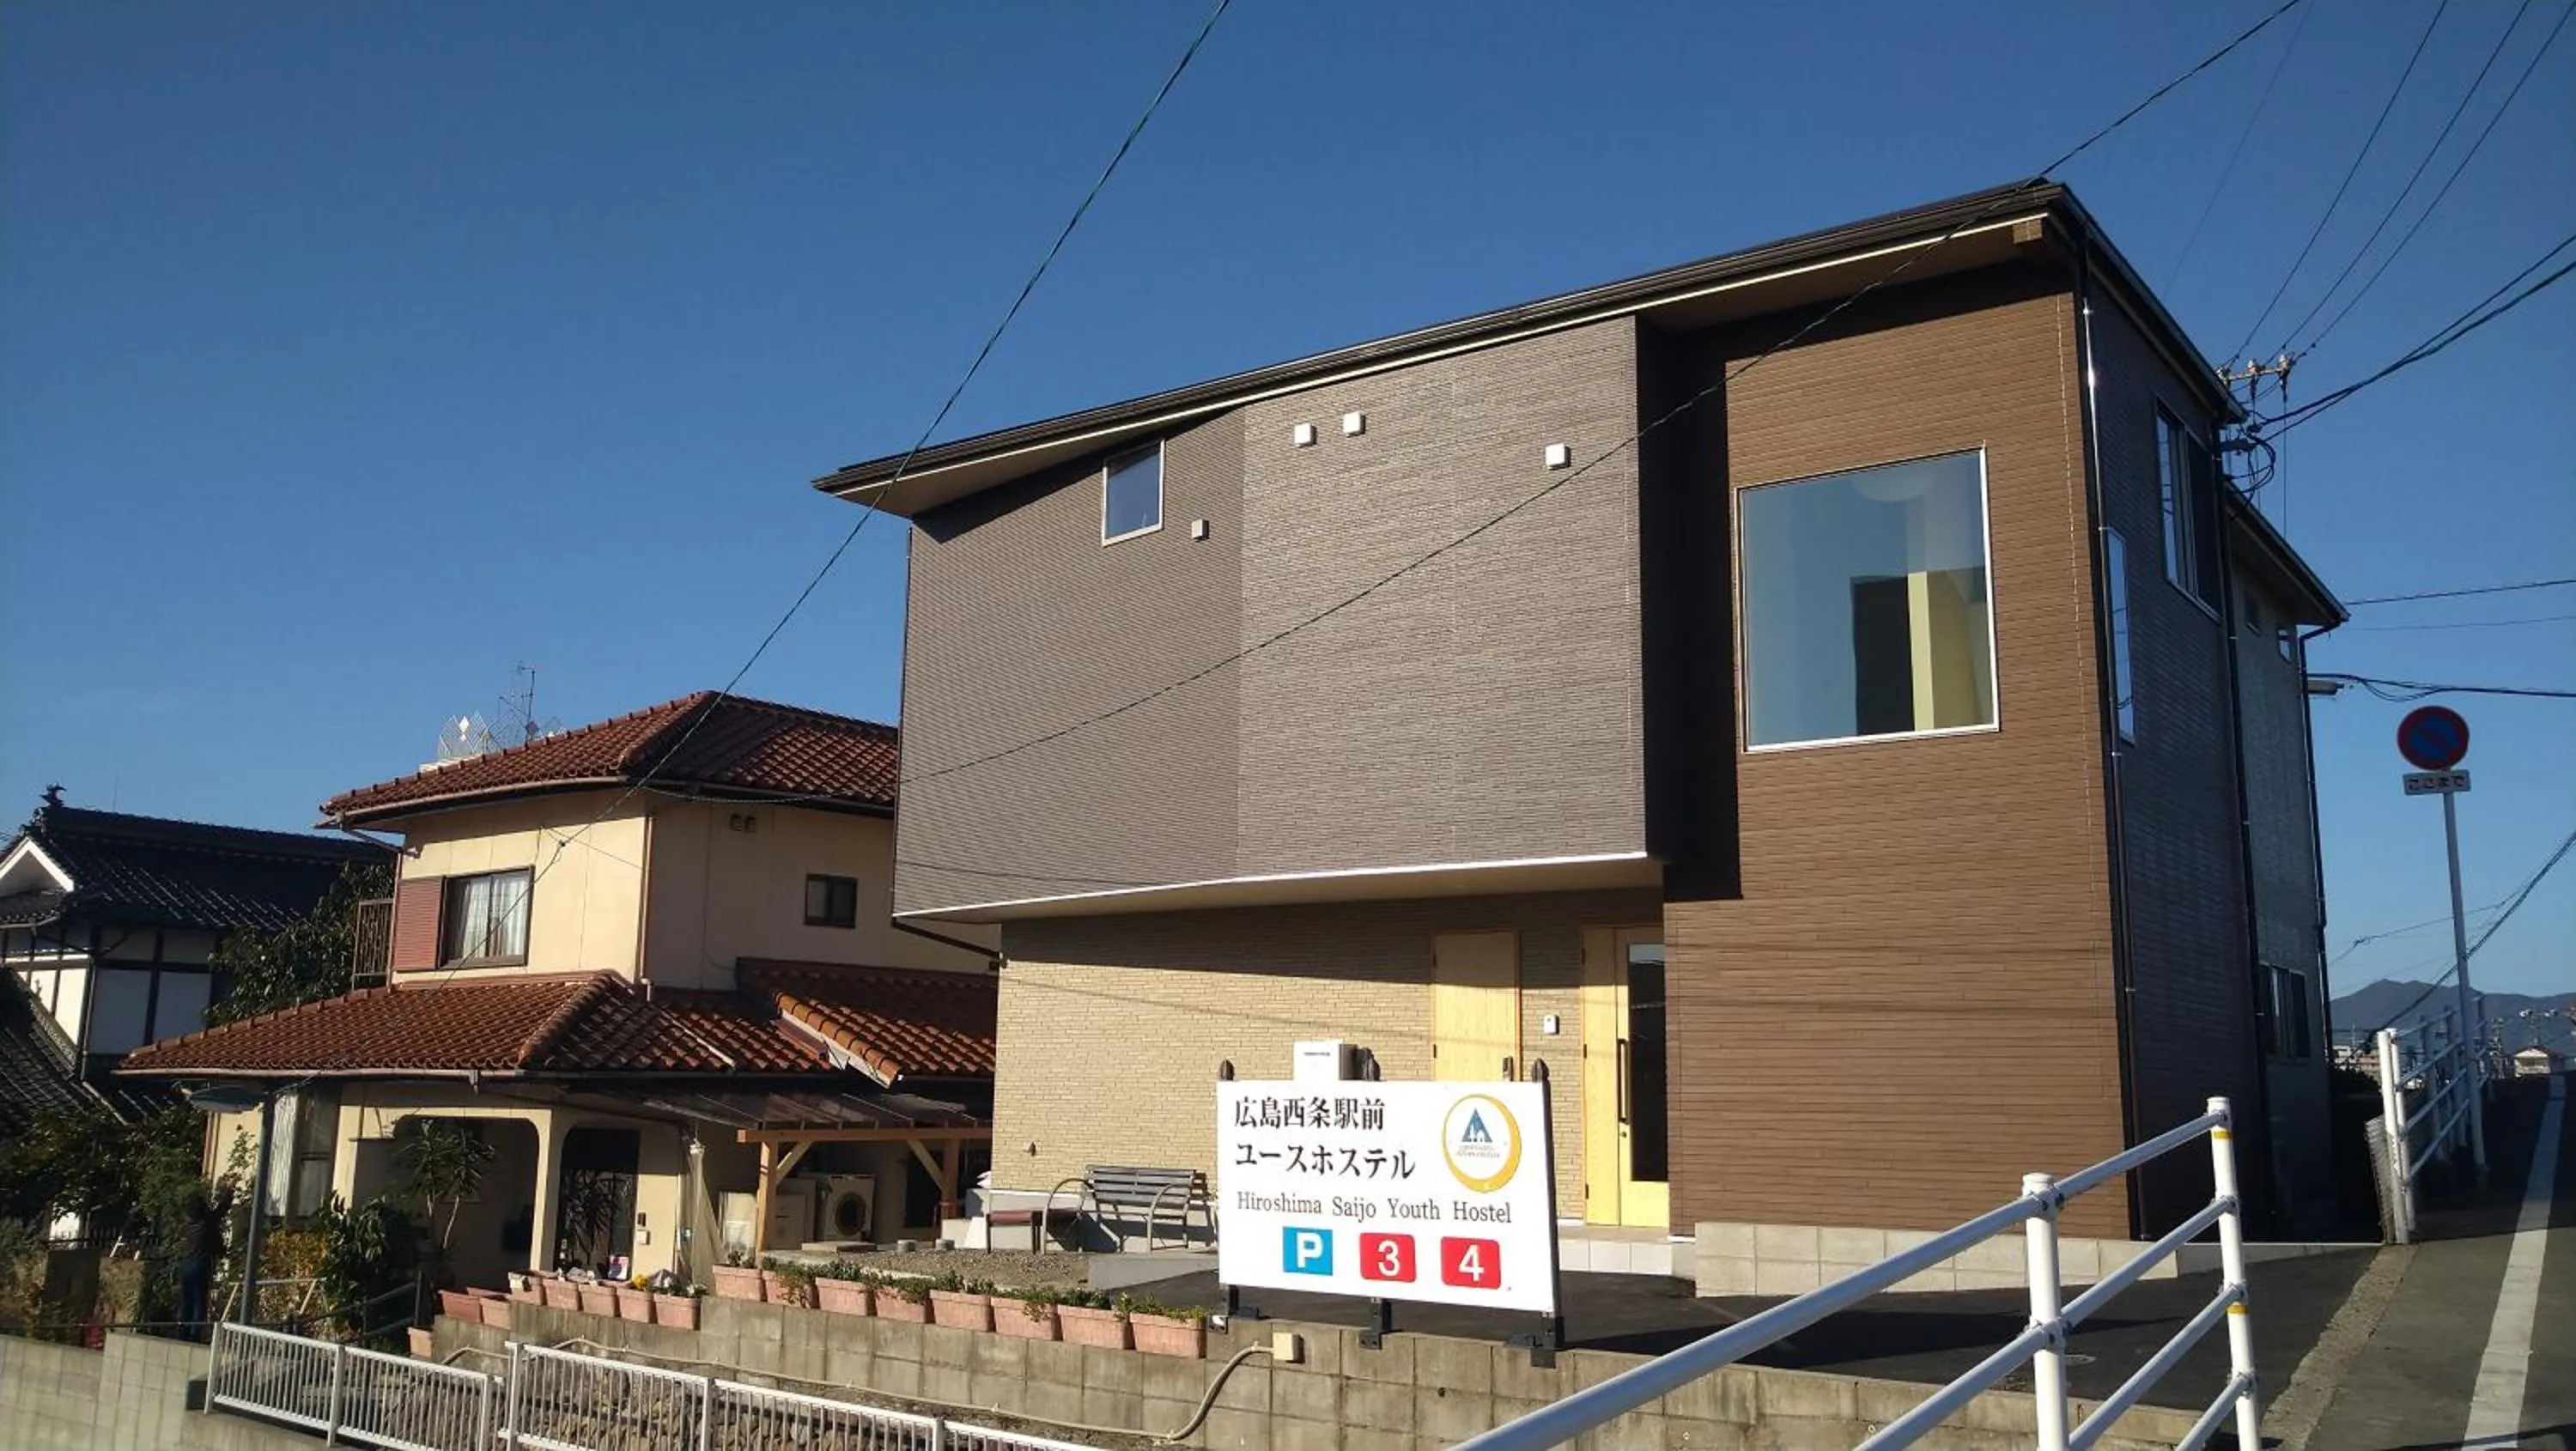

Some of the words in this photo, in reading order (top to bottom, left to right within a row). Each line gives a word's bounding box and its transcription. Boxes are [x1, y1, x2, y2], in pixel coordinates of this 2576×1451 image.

[1234, 1096, 1386, 1130] 広島西条駅前
[1235, 1143, 1416, 1181] ユースホステル
[1237, 1192, 1322, 1215] Hiroshima
[1332, 1196, 1376, 1223] Saijo
[1388, 1199, 1441, 1220] Youth
[1453, 1201, 1511, 1223] Hostel
[1297, 1232, 1323, 1268] P
[1377, 1241, 1400, 1277] 3
[1459, 1244, 1485, 1282] 4
